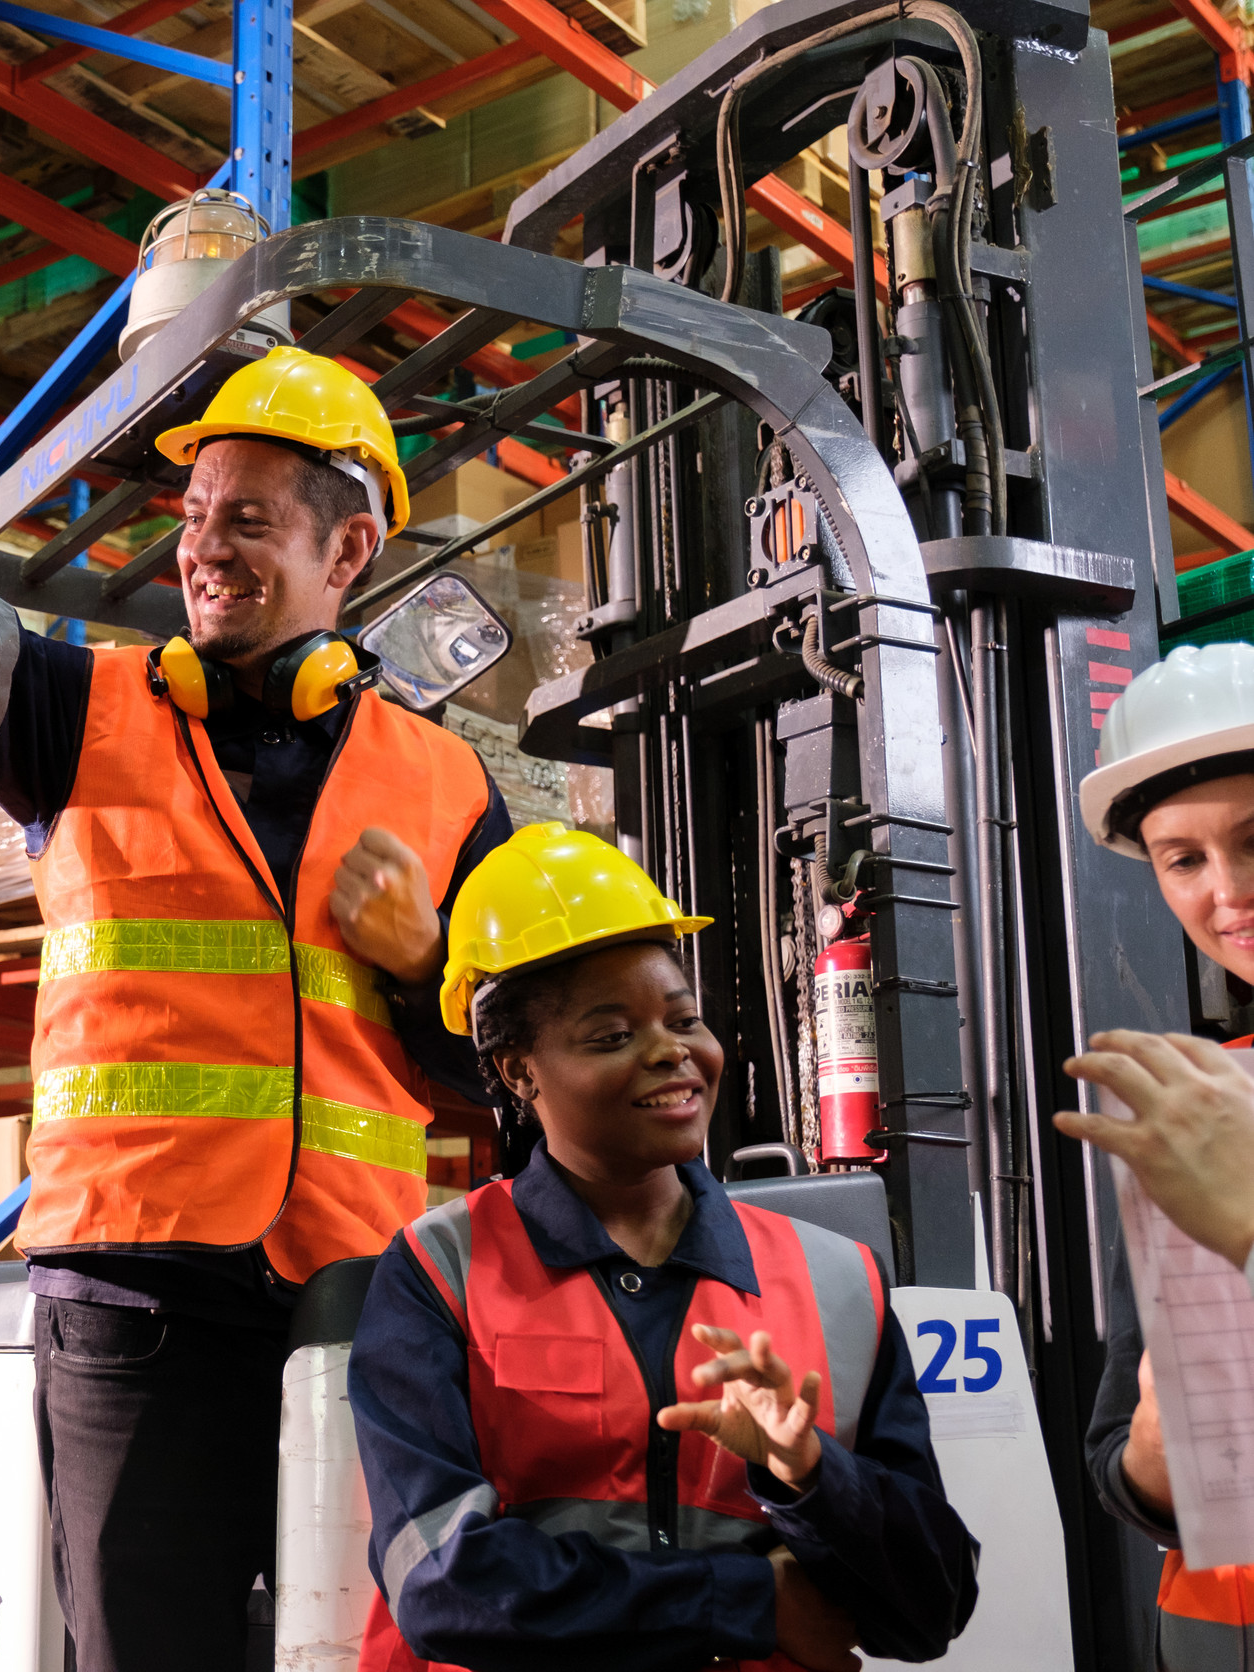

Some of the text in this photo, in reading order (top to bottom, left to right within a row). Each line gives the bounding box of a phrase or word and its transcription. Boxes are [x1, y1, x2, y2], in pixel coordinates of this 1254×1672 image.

[20, 363, 138, 501] NICHIYU
[815, 981, 873, 1001] PERIA
[917, 1318, 1002, 1394] 25
